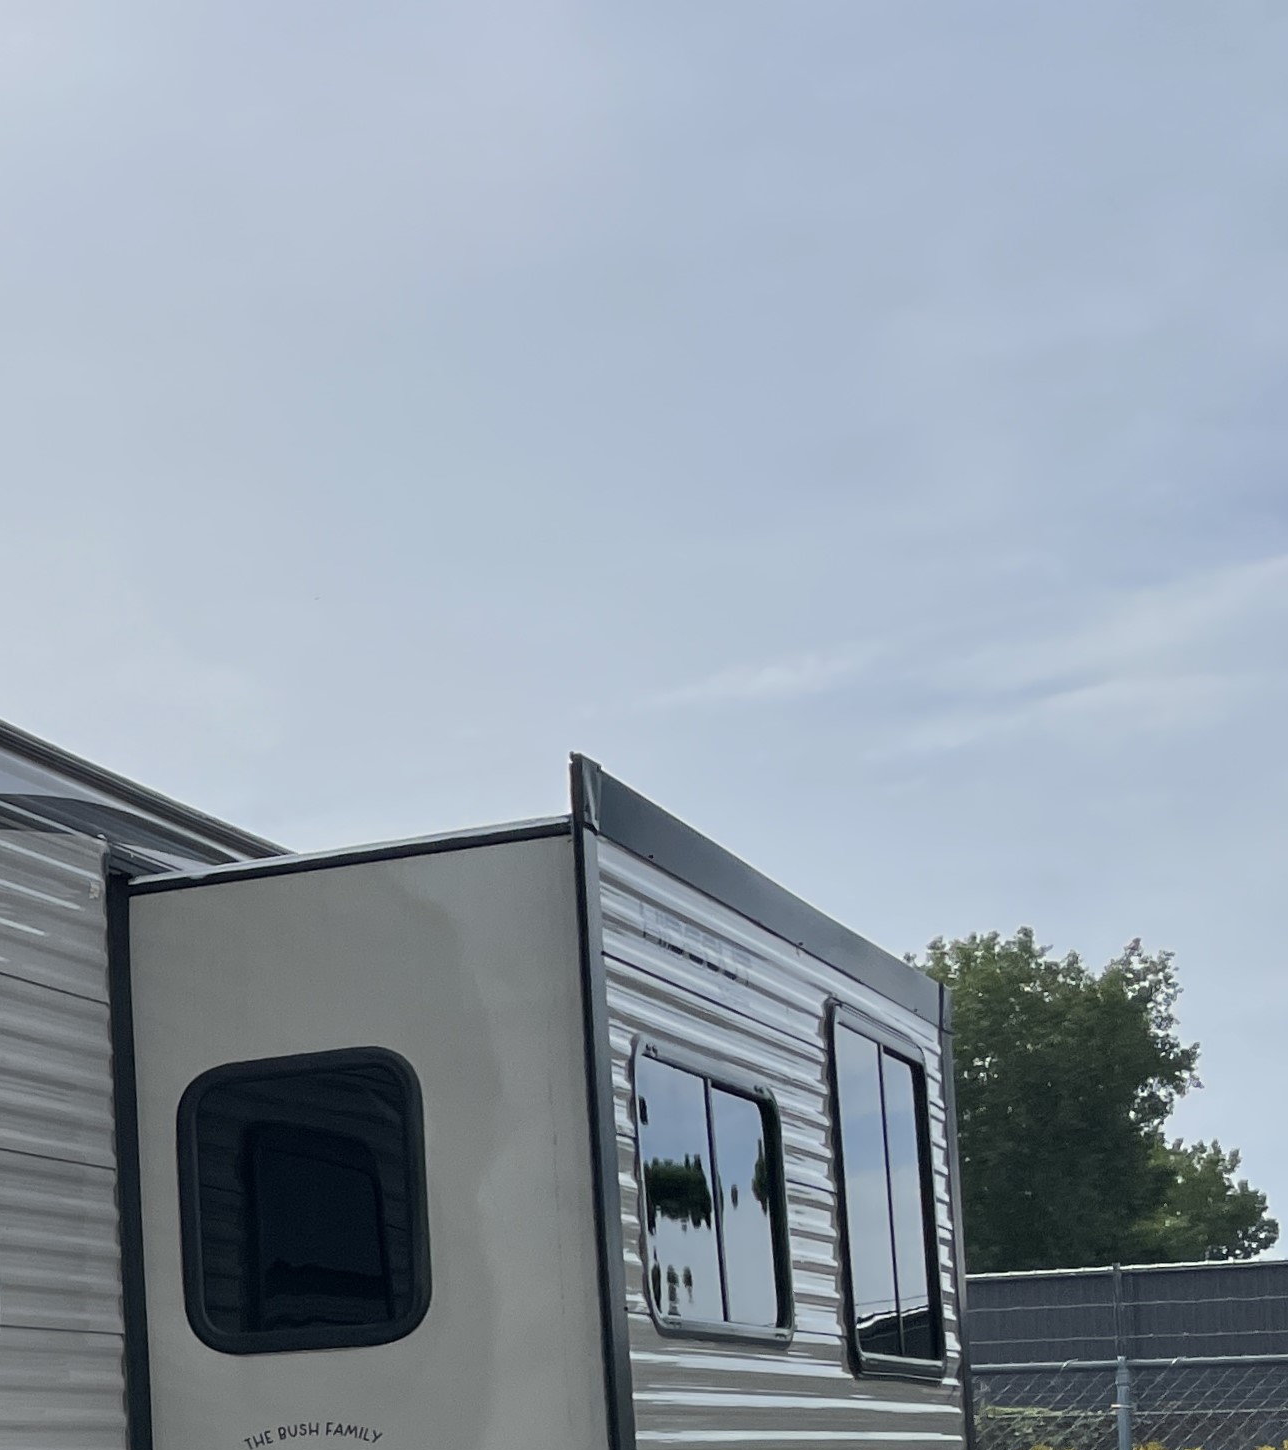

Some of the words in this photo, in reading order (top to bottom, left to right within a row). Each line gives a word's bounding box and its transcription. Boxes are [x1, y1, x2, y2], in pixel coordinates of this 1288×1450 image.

[244, 1430, 274, 1450] THE
[277, 1422, 320, 1441] BUSH
[325, 1421, 383, 1444] FAMILY
